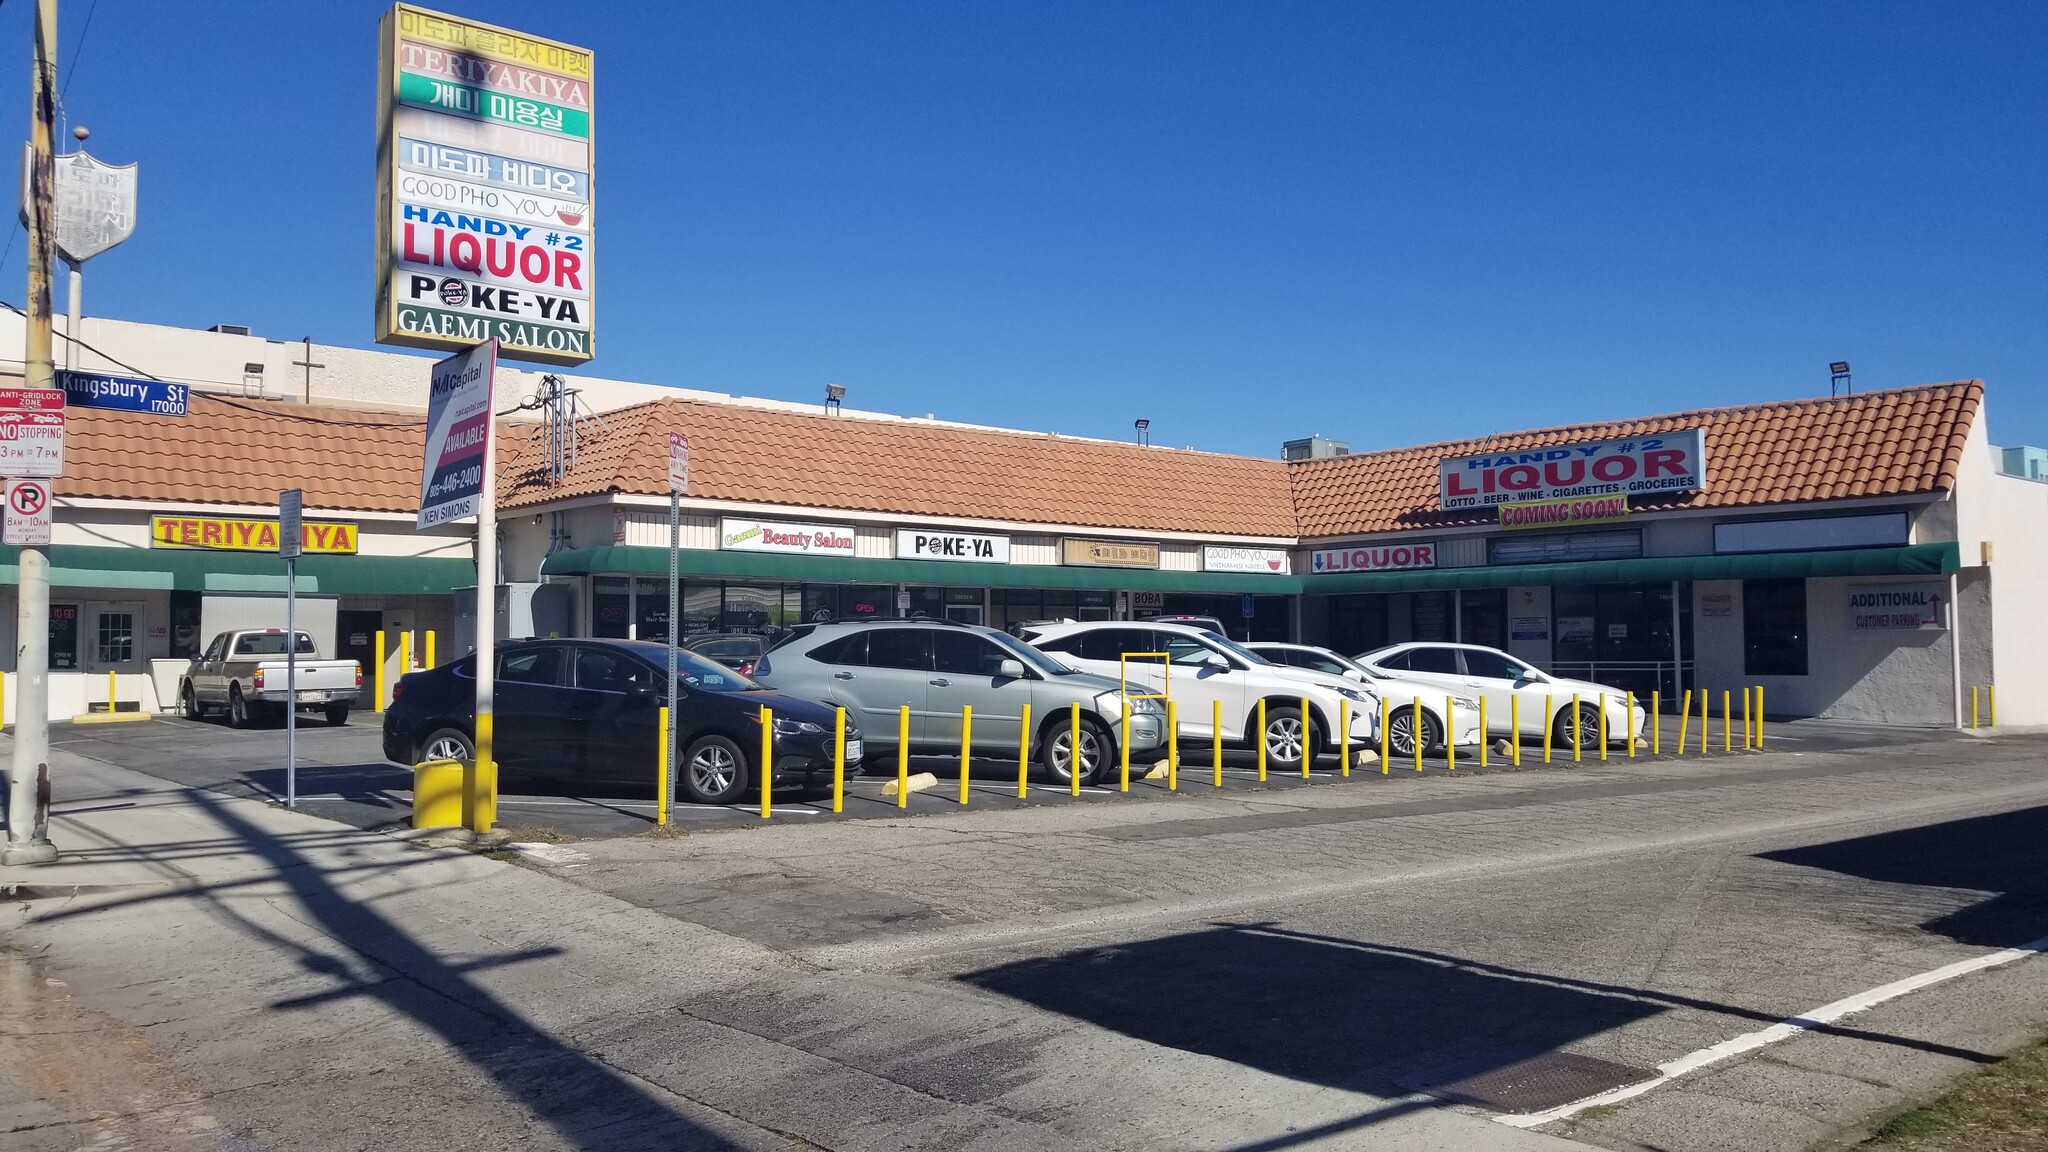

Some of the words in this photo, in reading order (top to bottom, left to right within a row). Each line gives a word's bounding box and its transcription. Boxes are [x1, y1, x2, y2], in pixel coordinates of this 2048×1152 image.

[400, 12, 468, 47] 미도파
[476, 29, 539, 63] 플라자
[547, 47, 588, 75] 마켓
[401, 42, 588, 106] TERIYAKIYA
[429, 81, 480, 114] 개미
[490, 95, 563, 132] 미용실
[411, 142, 491, 179] 미도파
[502, 160, 577, 195] 비디오
[402, 176, 457, 201] GOOD
[460, 185, 499, 208] PHO
[502, 193, 557, 218] YOU
[403, 204, 532, 241] HANDY
[545, 231, 583, 251] #2
[403, 222, 583, 291] LIQUOR
[398, 309, 490, 341] GAEMI
[498, 322, 585, 353] SALON
[62, 372, 148, 403] Kingsbury
[167, 384, 185, 402] St
[431, 370, 450, 397] NAI
[450, 362, 482, 391] Capital
[0, 391, 62, 400] ANTI-GRIDLOCK
[151, 400, 185, 414] 17000
[454, 399, 487, 418] naicapital.com
[0, 424, 18, 440] NO
[20, 427, 62, 439] STOPPING
[444, 423, 485, 454] AVAILABLE
[11, 450, 24, 458] PM
[36, 446, 43, 458] 7
[45, 451, 58, 459] PM
[1468, 445, 1603, 470] HANDY
[1616, 439, 1664, 453] #2
[429, 464, 481, 498] 805-446-2400
[1447, 449, 1690, 497] LIQUOR
[1445, 497, 1476, 508] LOTTO
[1484, 494, 1510, 505] BEER
[1517, 490, 1544, 501] WINE
[1552, 483, 1619, 498] CIGARETTES
[1629, 476, 1695, 491] GROCERIES
[7, 517, 23, 526] 8AM
[30, 517, 48, 526] 10AM
[424, 504, 439, 524] KEN
[440, 500, 470, 520] SIMONS
[1502, 502, 1569, 527] COMING
[1571, 497, 1626, 521] SOON!
[158, 519, 351, 550] TERIYAIYA
[762, 528, 812, 551] Beauty
[814, 531, 853, 549] Salon
[1206, 548, 1229, 560] GOOD
[1230, 549, 1247, 560] PHO
[1247, 550, 1270, 561] YOU
[1327, 545, 1433, 571] LIQUOR
[730, 603, 749, 612] Hair
[856, 603, 875, 612] OPEN
[1134, 592, 1161, 604] BOBA
[1850, 592, 1928, 607] ADDITIONAL
[1856, 614, 1890, 628] CUSTOMER
[1891, 613, 1920, 627] PARKING
